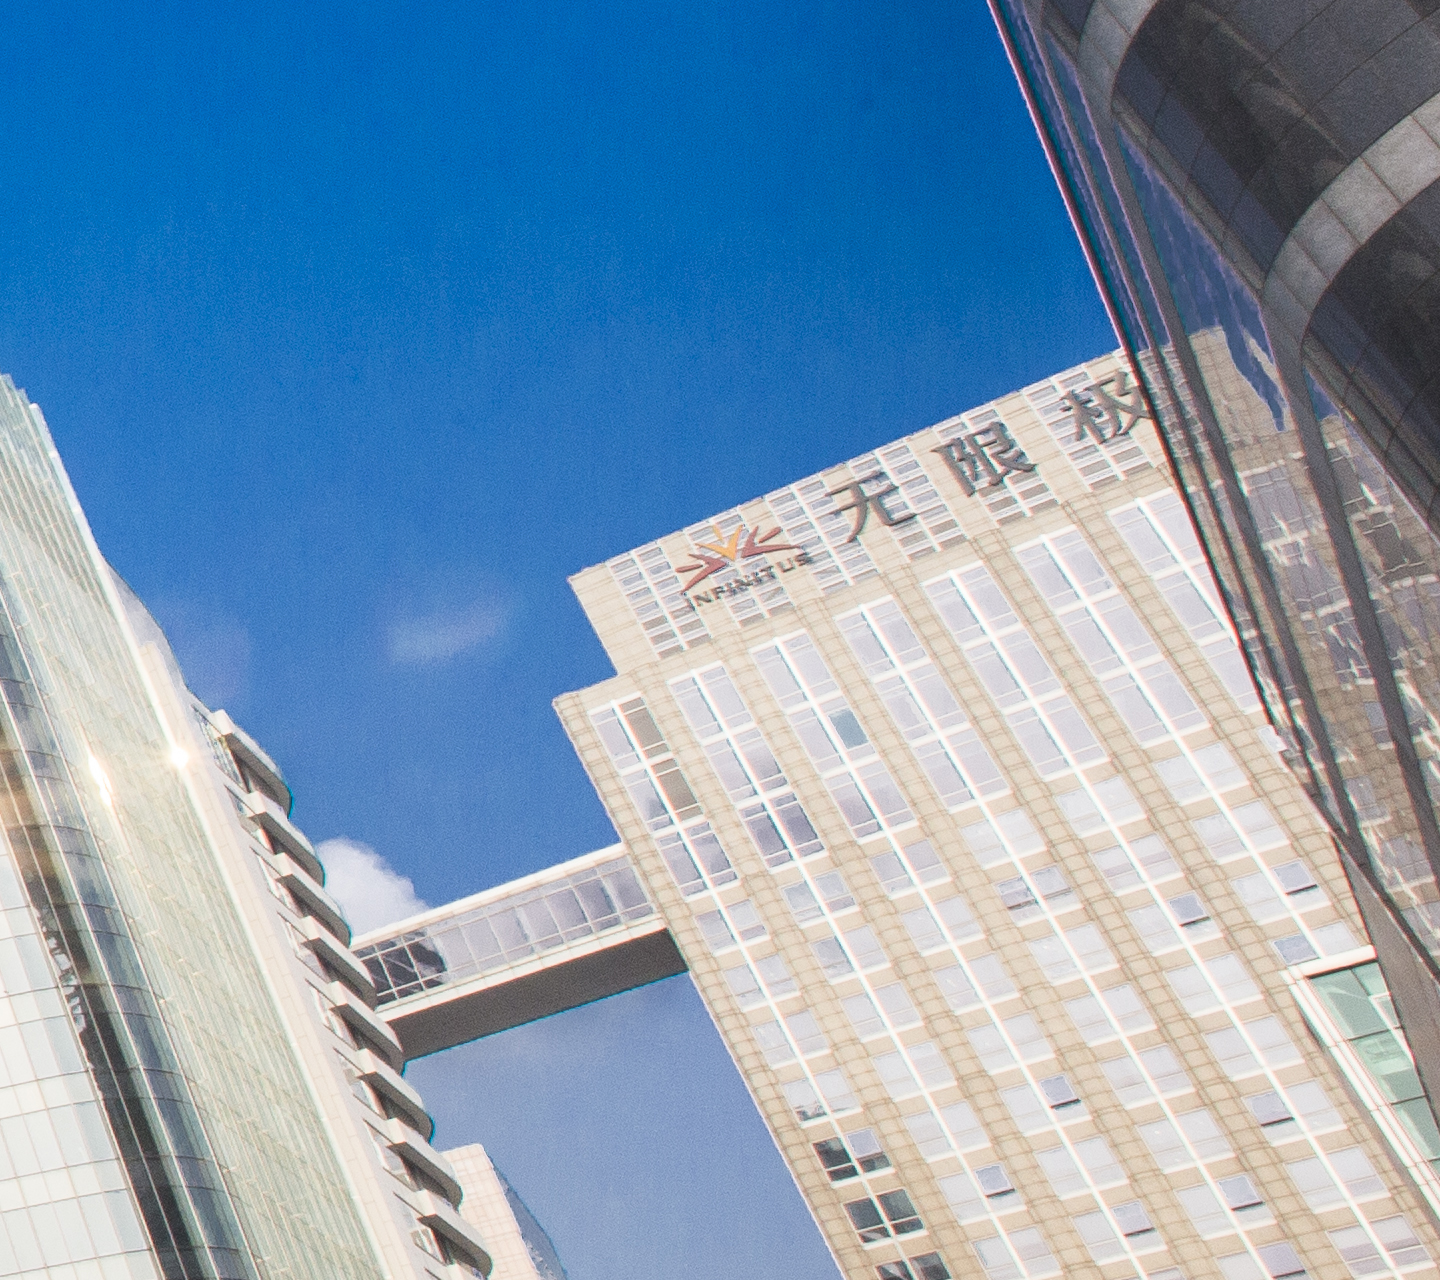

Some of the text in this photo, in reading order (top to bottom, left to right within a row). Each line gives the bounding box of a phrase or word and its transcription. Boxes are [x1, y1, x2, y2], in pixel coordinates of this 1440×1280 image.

[824, 370, 1154, 543] 无限极
[686, 550, 815, 612] INFINITUS
